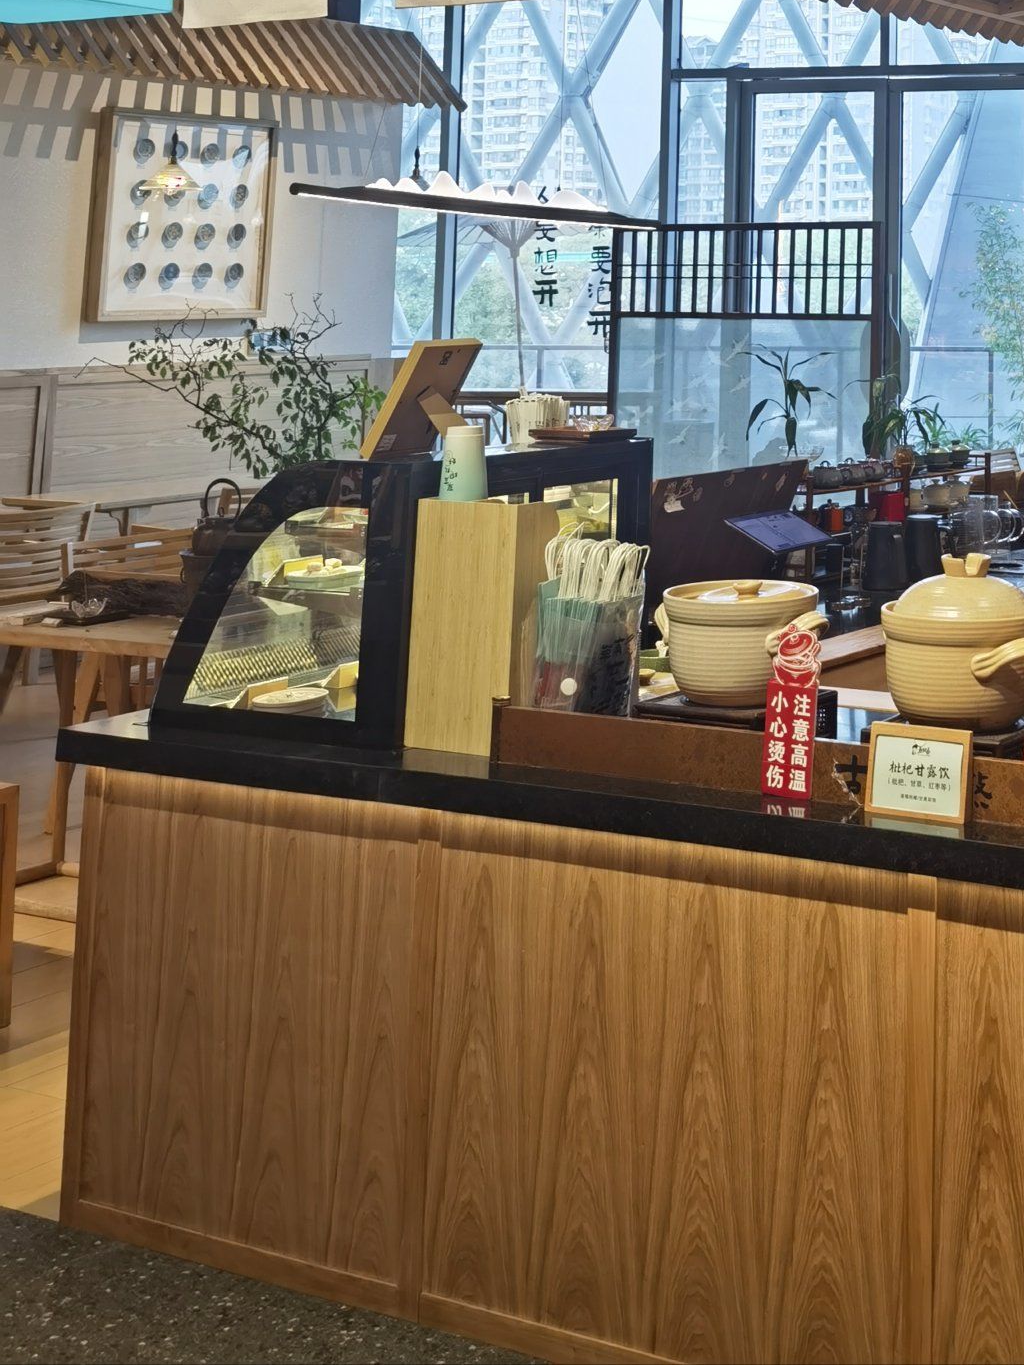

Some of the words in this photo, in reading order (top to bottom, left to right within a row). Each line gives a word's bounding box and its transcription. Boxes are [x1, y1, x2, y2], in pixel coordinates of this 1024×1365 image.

[765, 690, 790, 789] 小心烫伤
[788, 694, 812, 793] 注意高温
[888, 760, 951, 780] 枇杷甘露饮
